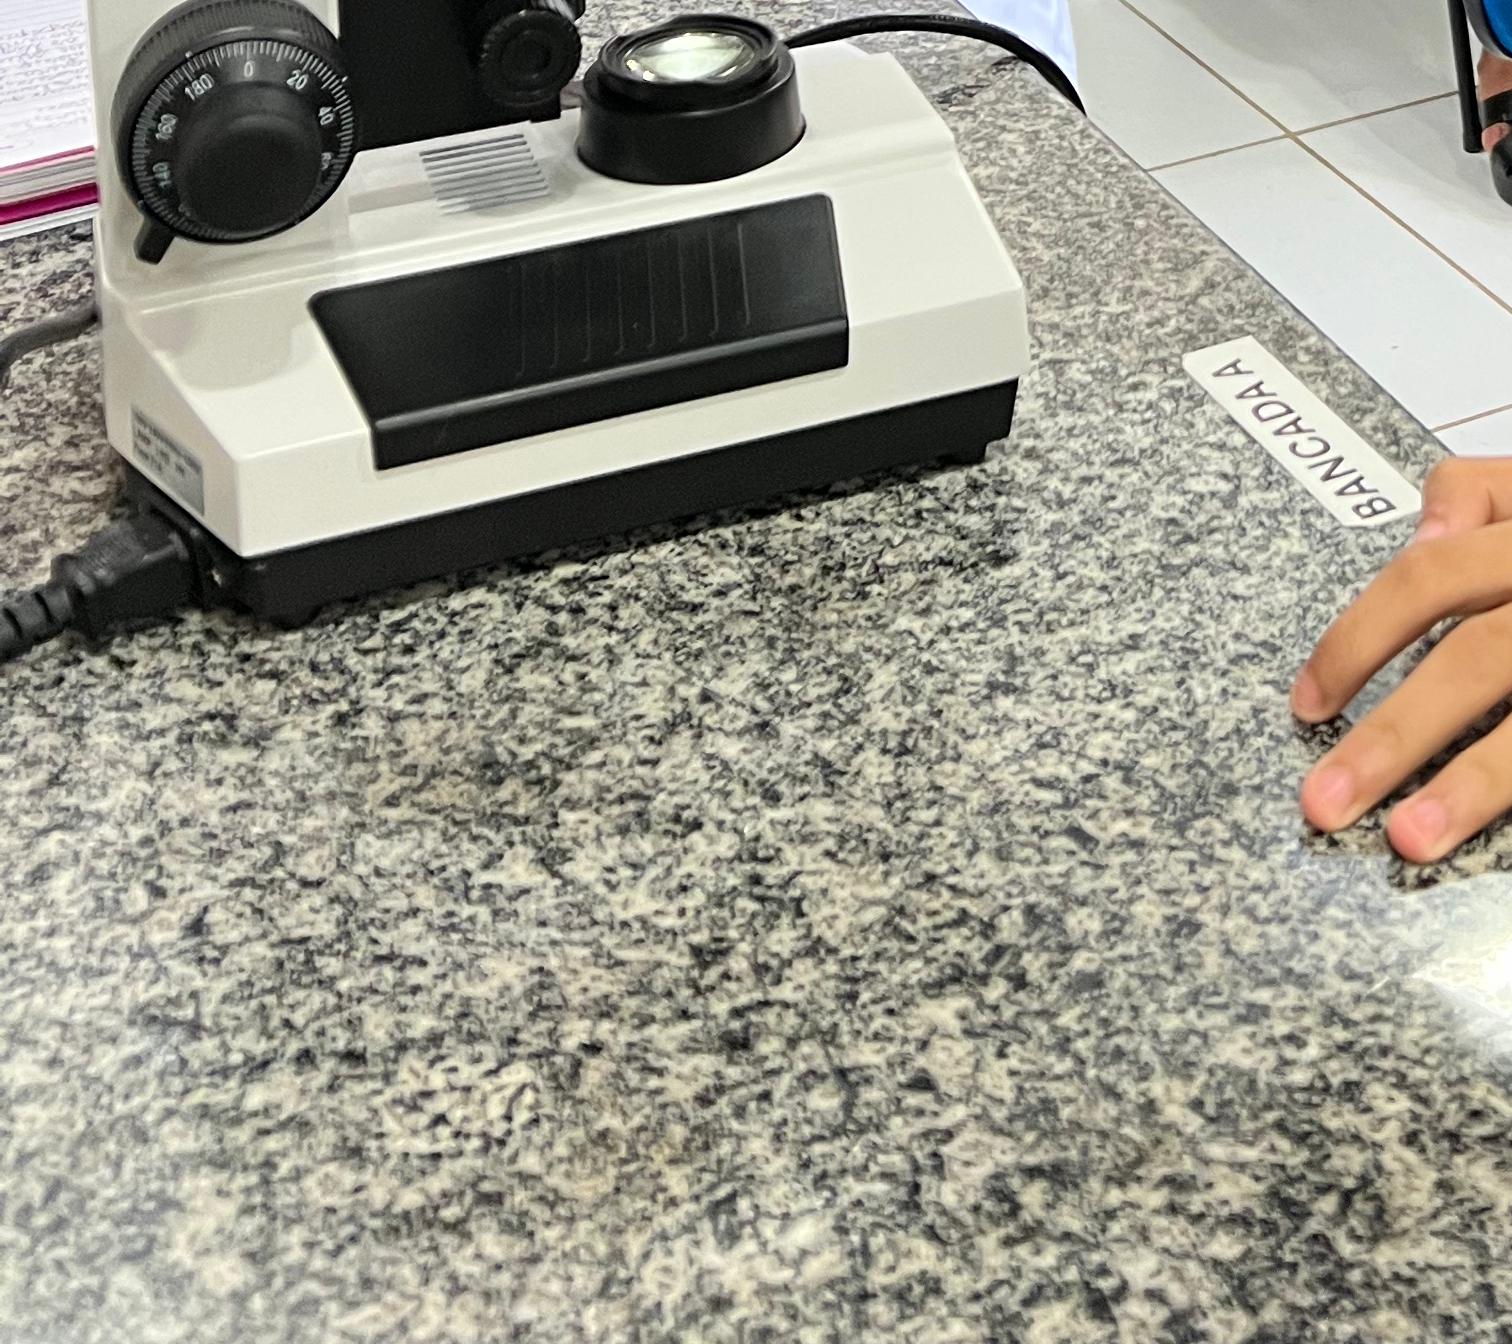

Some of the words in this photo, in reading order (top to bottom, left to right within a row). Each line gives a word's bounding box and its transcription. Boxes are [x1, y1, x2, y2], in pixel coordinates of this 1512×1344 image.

[243, 61, 255, 78] 0
[286, 69, 309, 90] 20
[185, 73, 215, 101] 180
[1212, 358, 1254, 378] A
[1235, 380, 1398, 520] BANCADA
